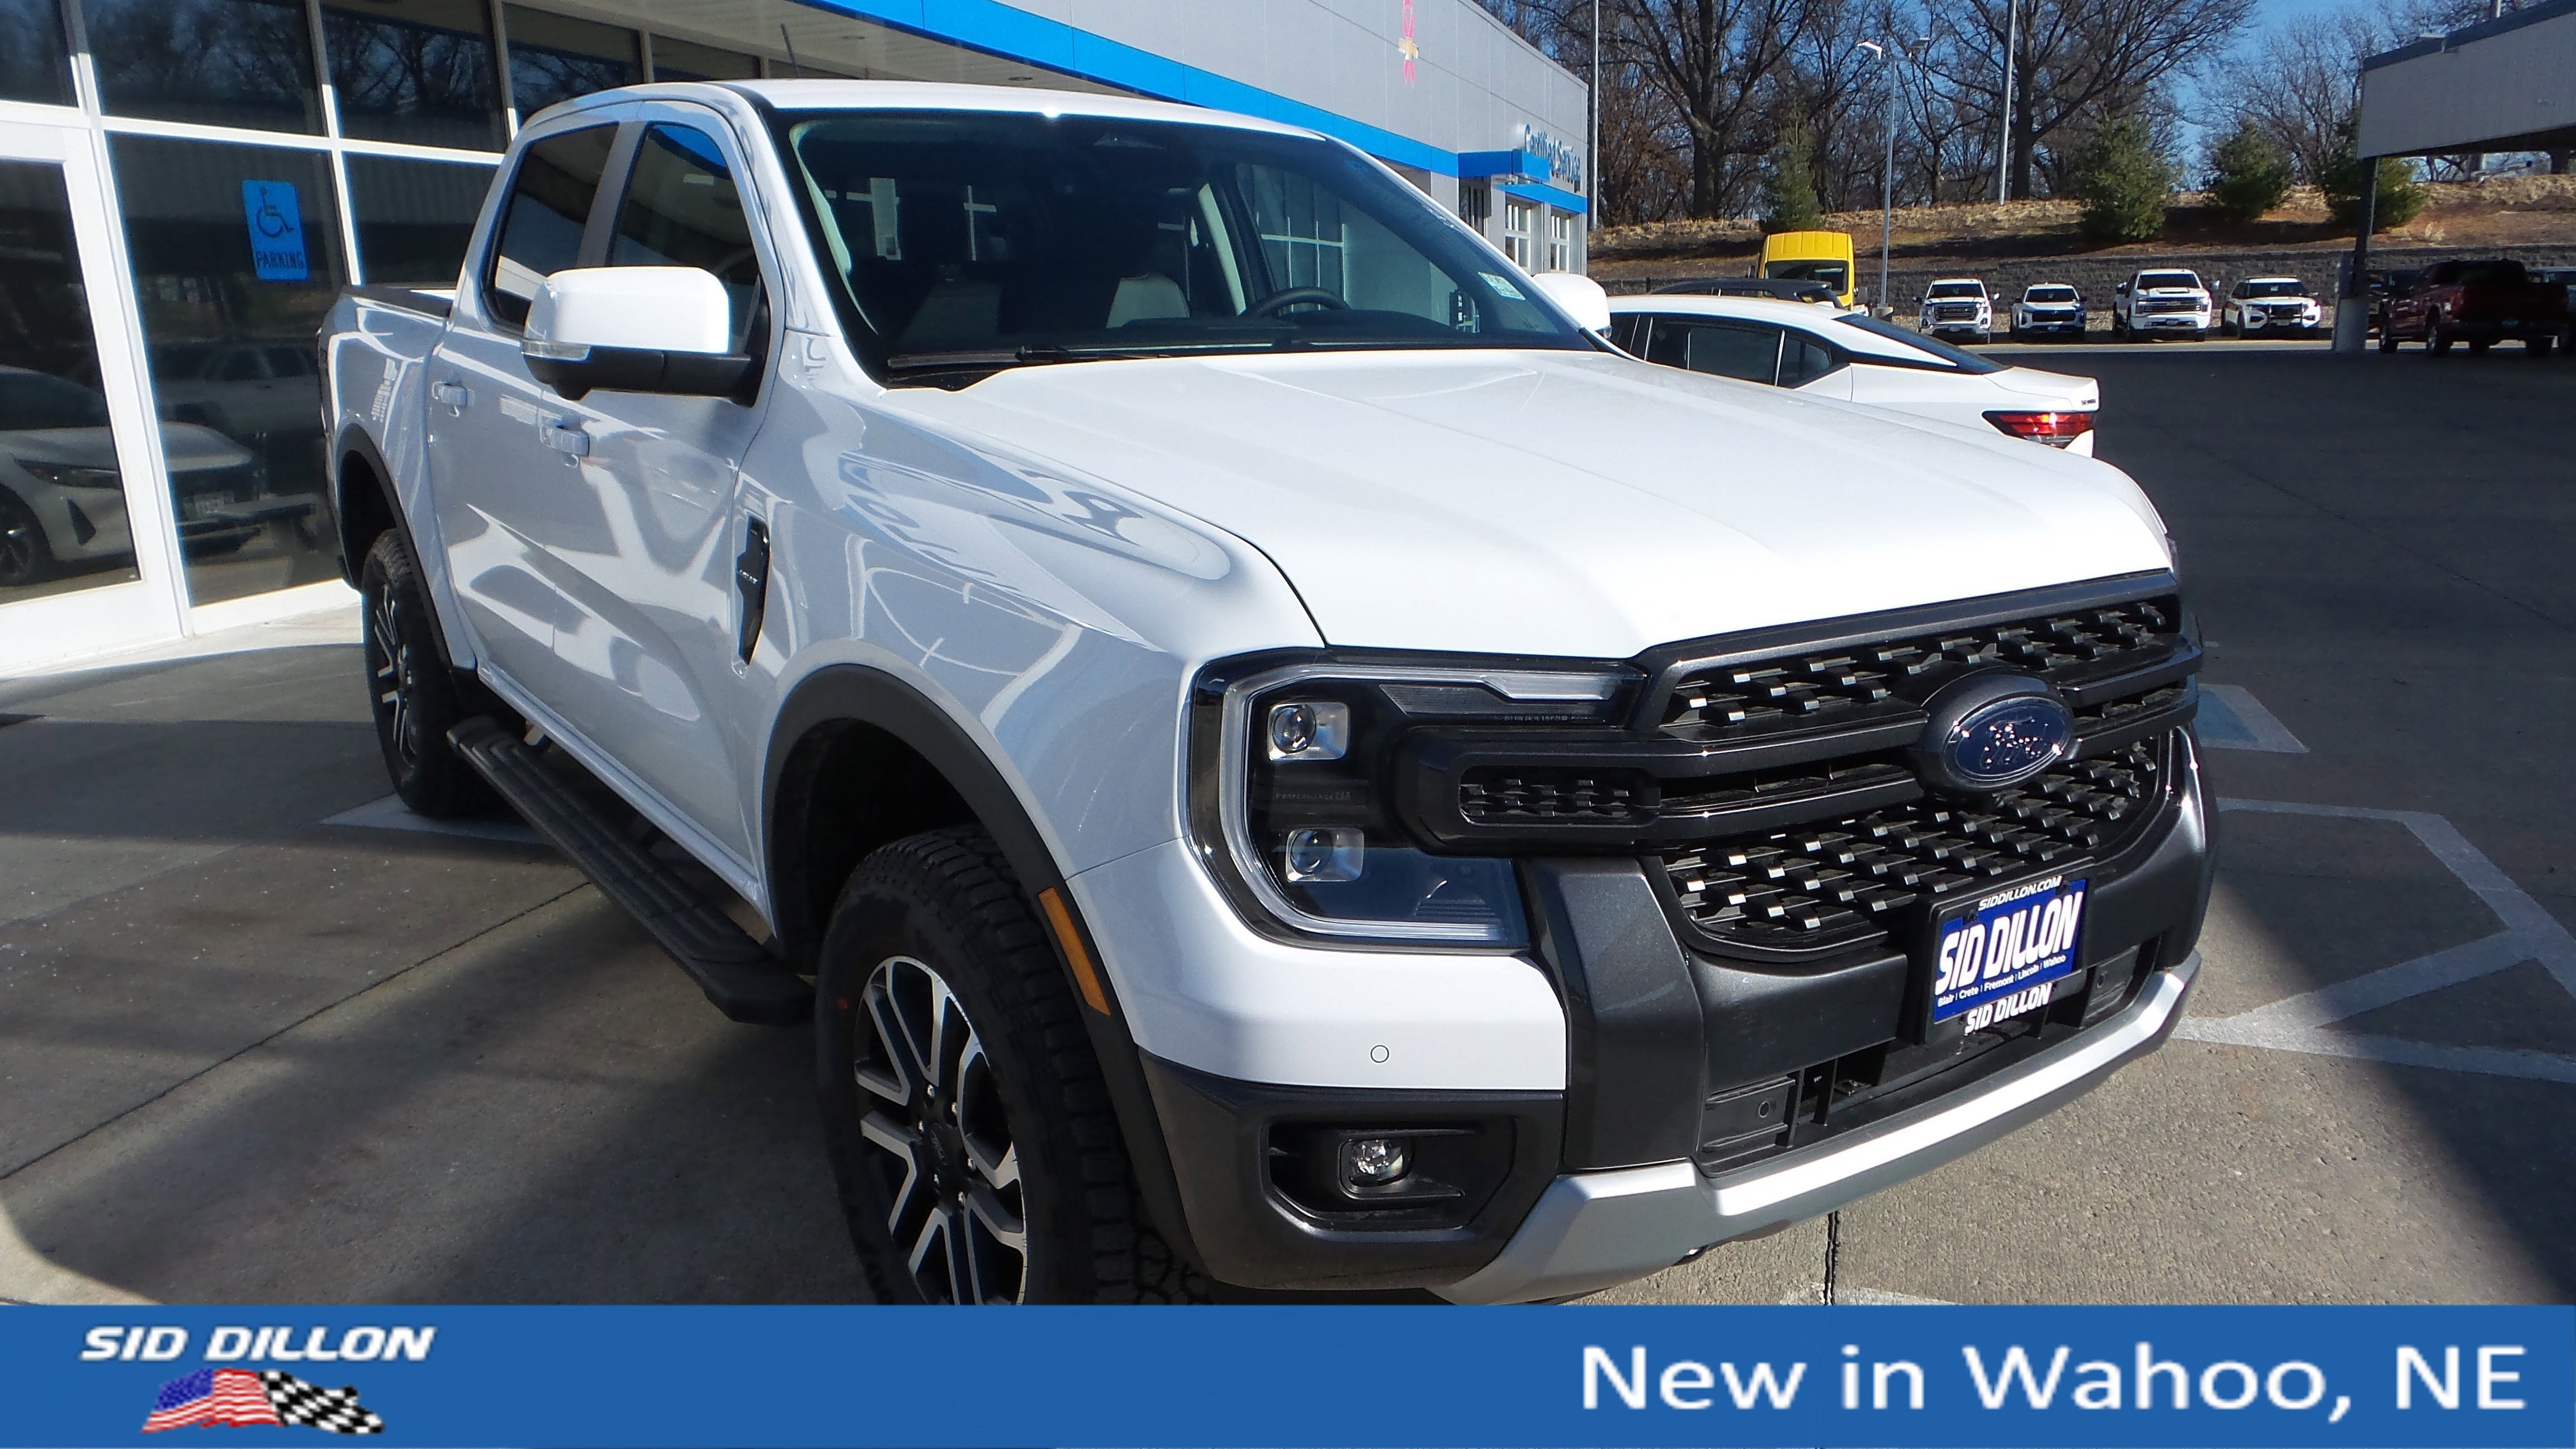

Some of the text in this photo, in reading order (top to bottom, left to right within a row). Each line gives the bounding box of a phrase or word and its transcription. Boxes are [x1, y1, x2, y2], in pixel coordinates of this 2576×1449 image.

[256, 251, 305, 269] PARKING
[1978, 875, 2062, 911] SIDDILLON.COM
[1935, 892, 2084, 995] SID DILLON
[1938, 955, 2066, 1007] Blair Crete Fremont Lincoln Wahoo
[1965, 982, 2053, 1034] SID DILLON
